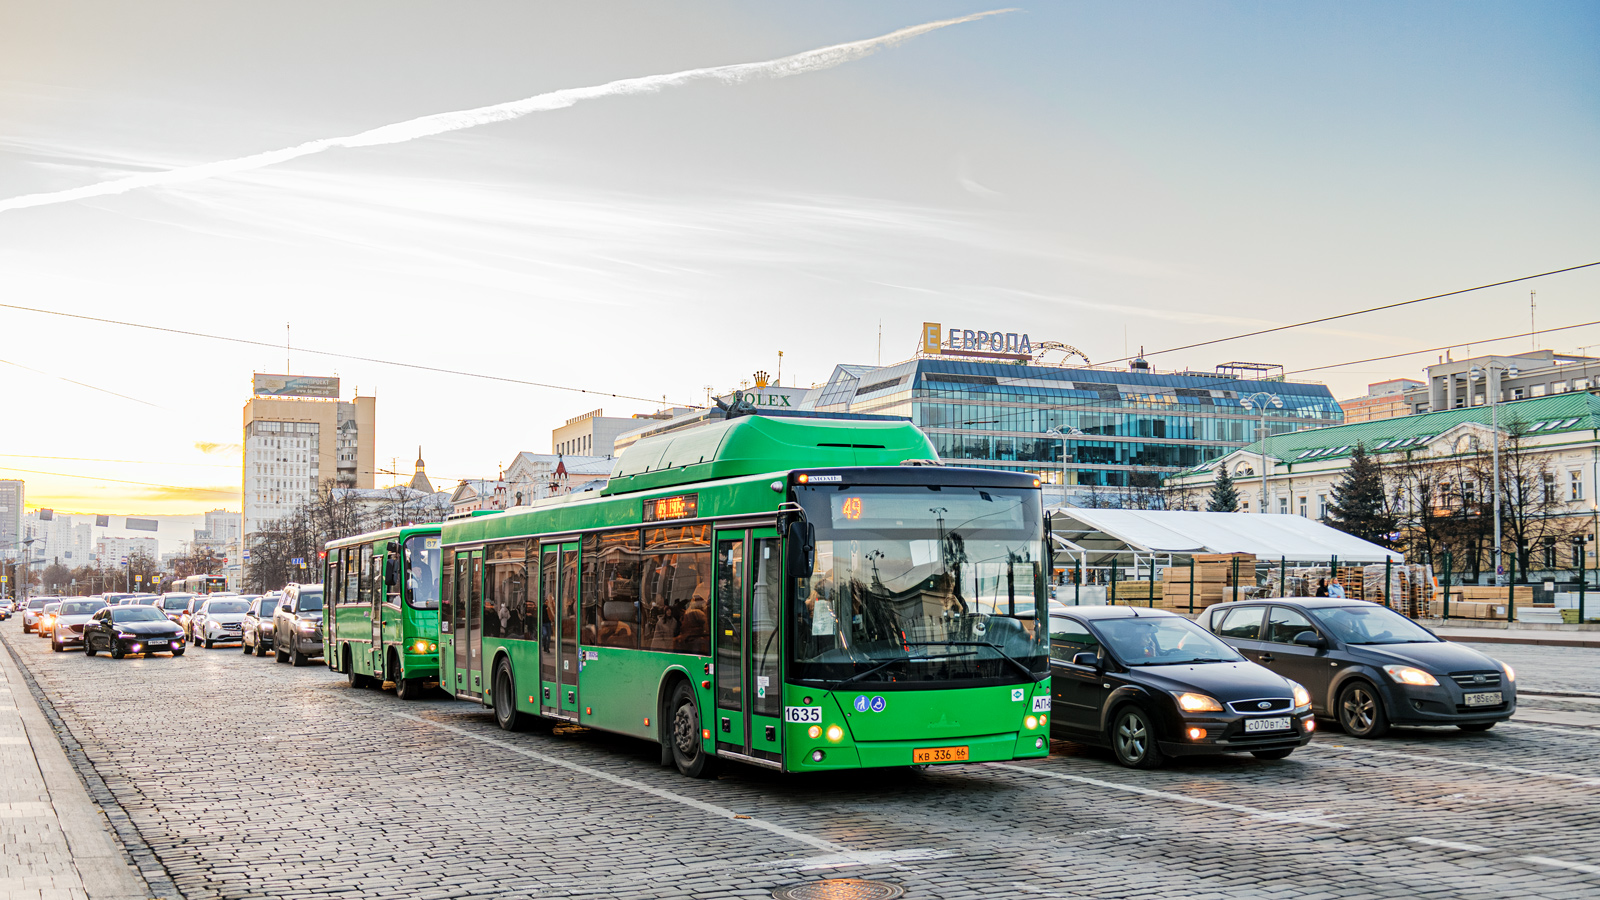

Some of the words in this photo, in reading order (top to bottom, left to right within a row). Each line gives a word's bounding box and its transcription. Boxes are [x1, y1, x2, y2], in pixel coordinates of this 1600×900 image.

[927, 326, 938, 347] Е
[949, 328, 1033, 354] ЕВРОПА
[733, 392, 791, 407] OLEX
[843, 497, 861, 519] 49
[426, 540, 437, 548] 87
[785, 707, 820, 721] 1635
[934, 750, 952, 760] 336
